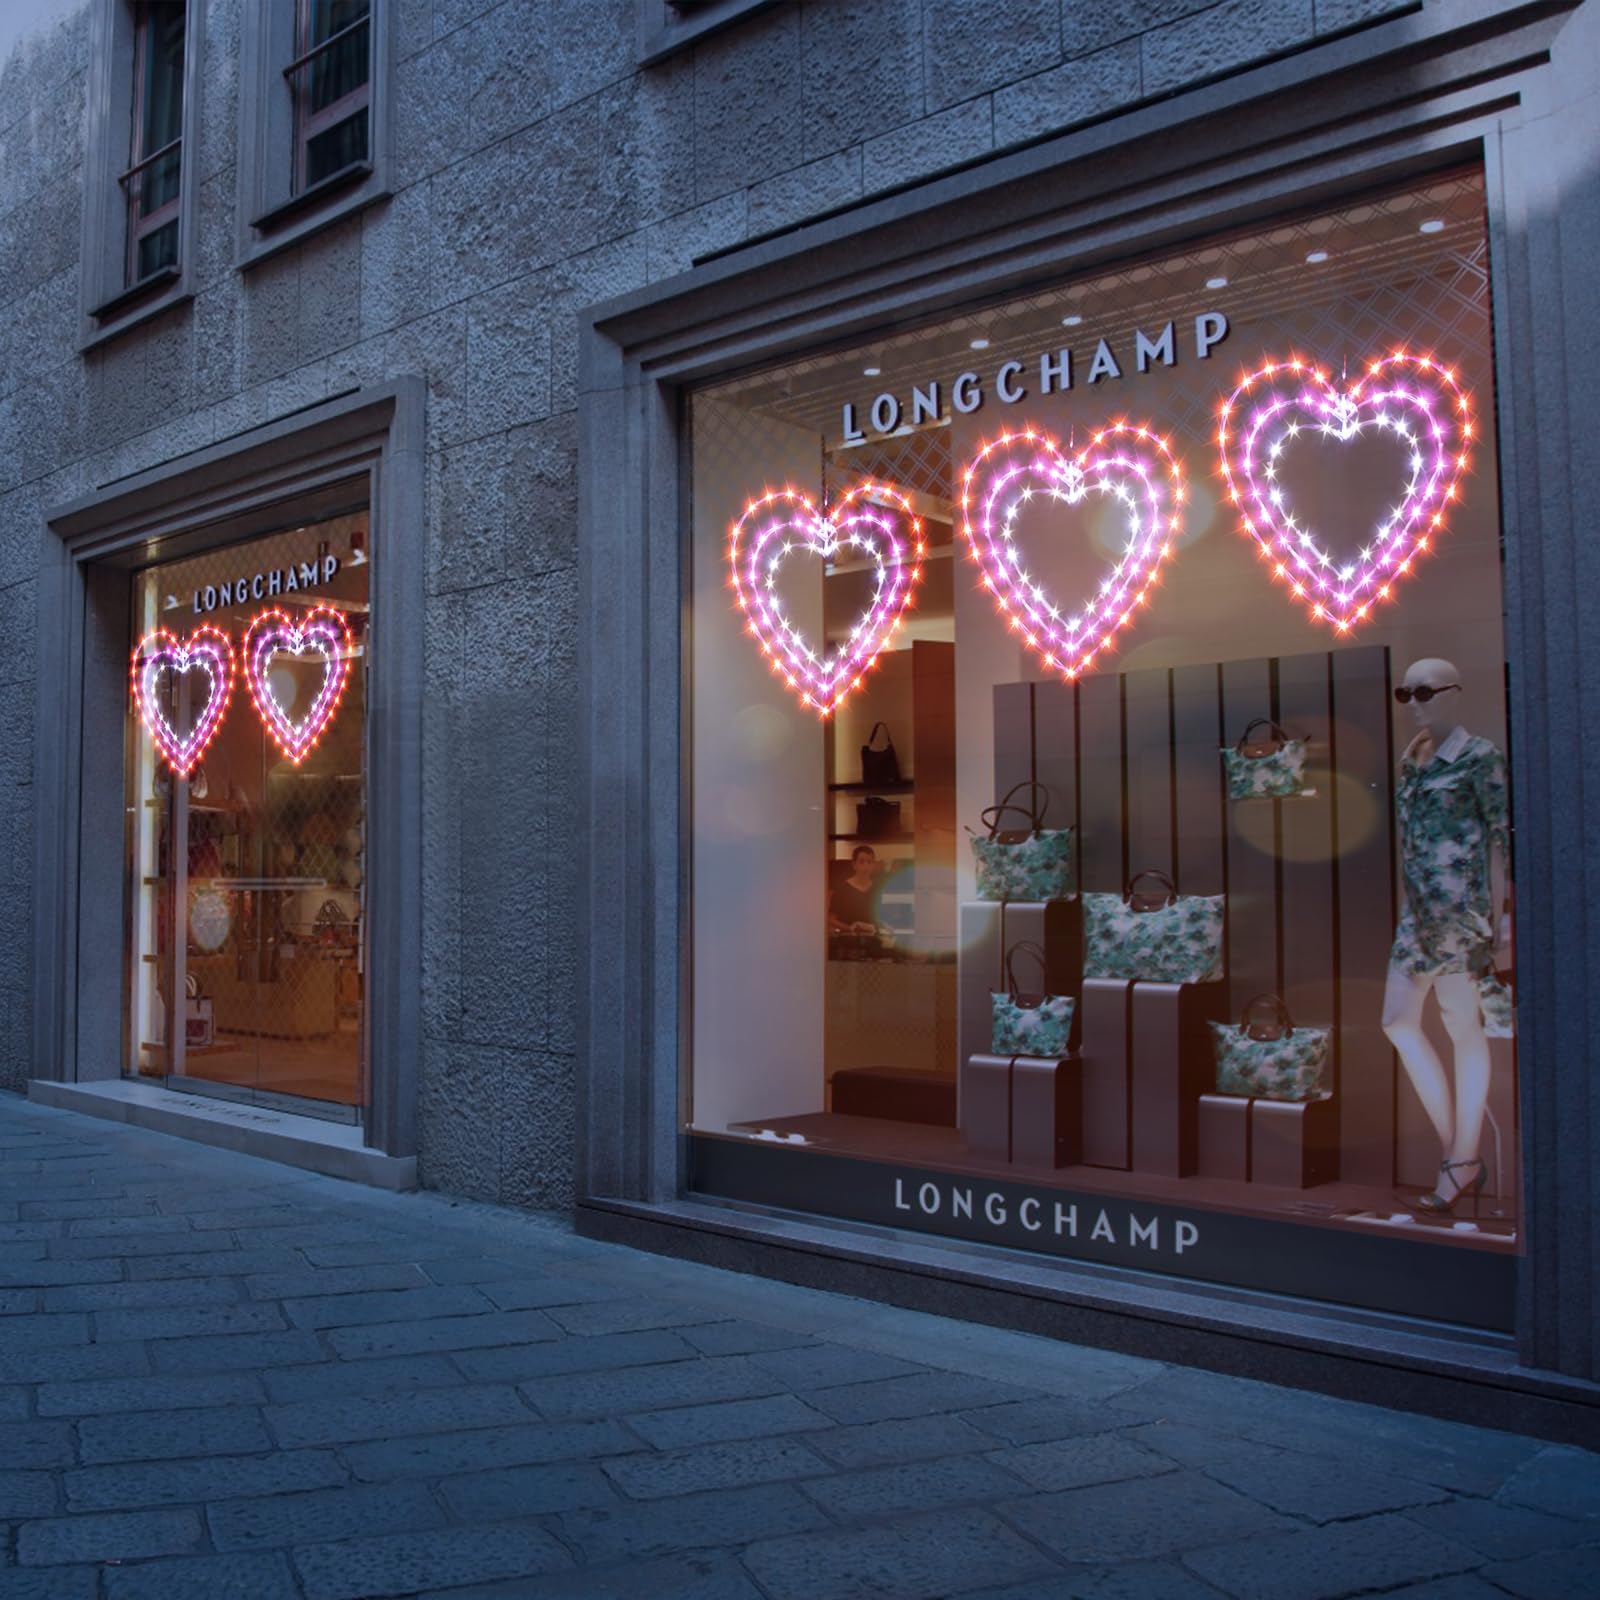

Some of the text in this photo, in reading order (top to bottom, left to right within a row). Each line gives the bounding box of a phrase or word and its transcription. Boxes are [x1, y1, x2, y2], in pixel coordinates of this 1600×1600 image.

[842, 312, 1228, 440] LONGCHAMP
[193, 555, 337, 614] LONGCHAMP
[895, 1178, 1199, 1254] LONGCHAMP
